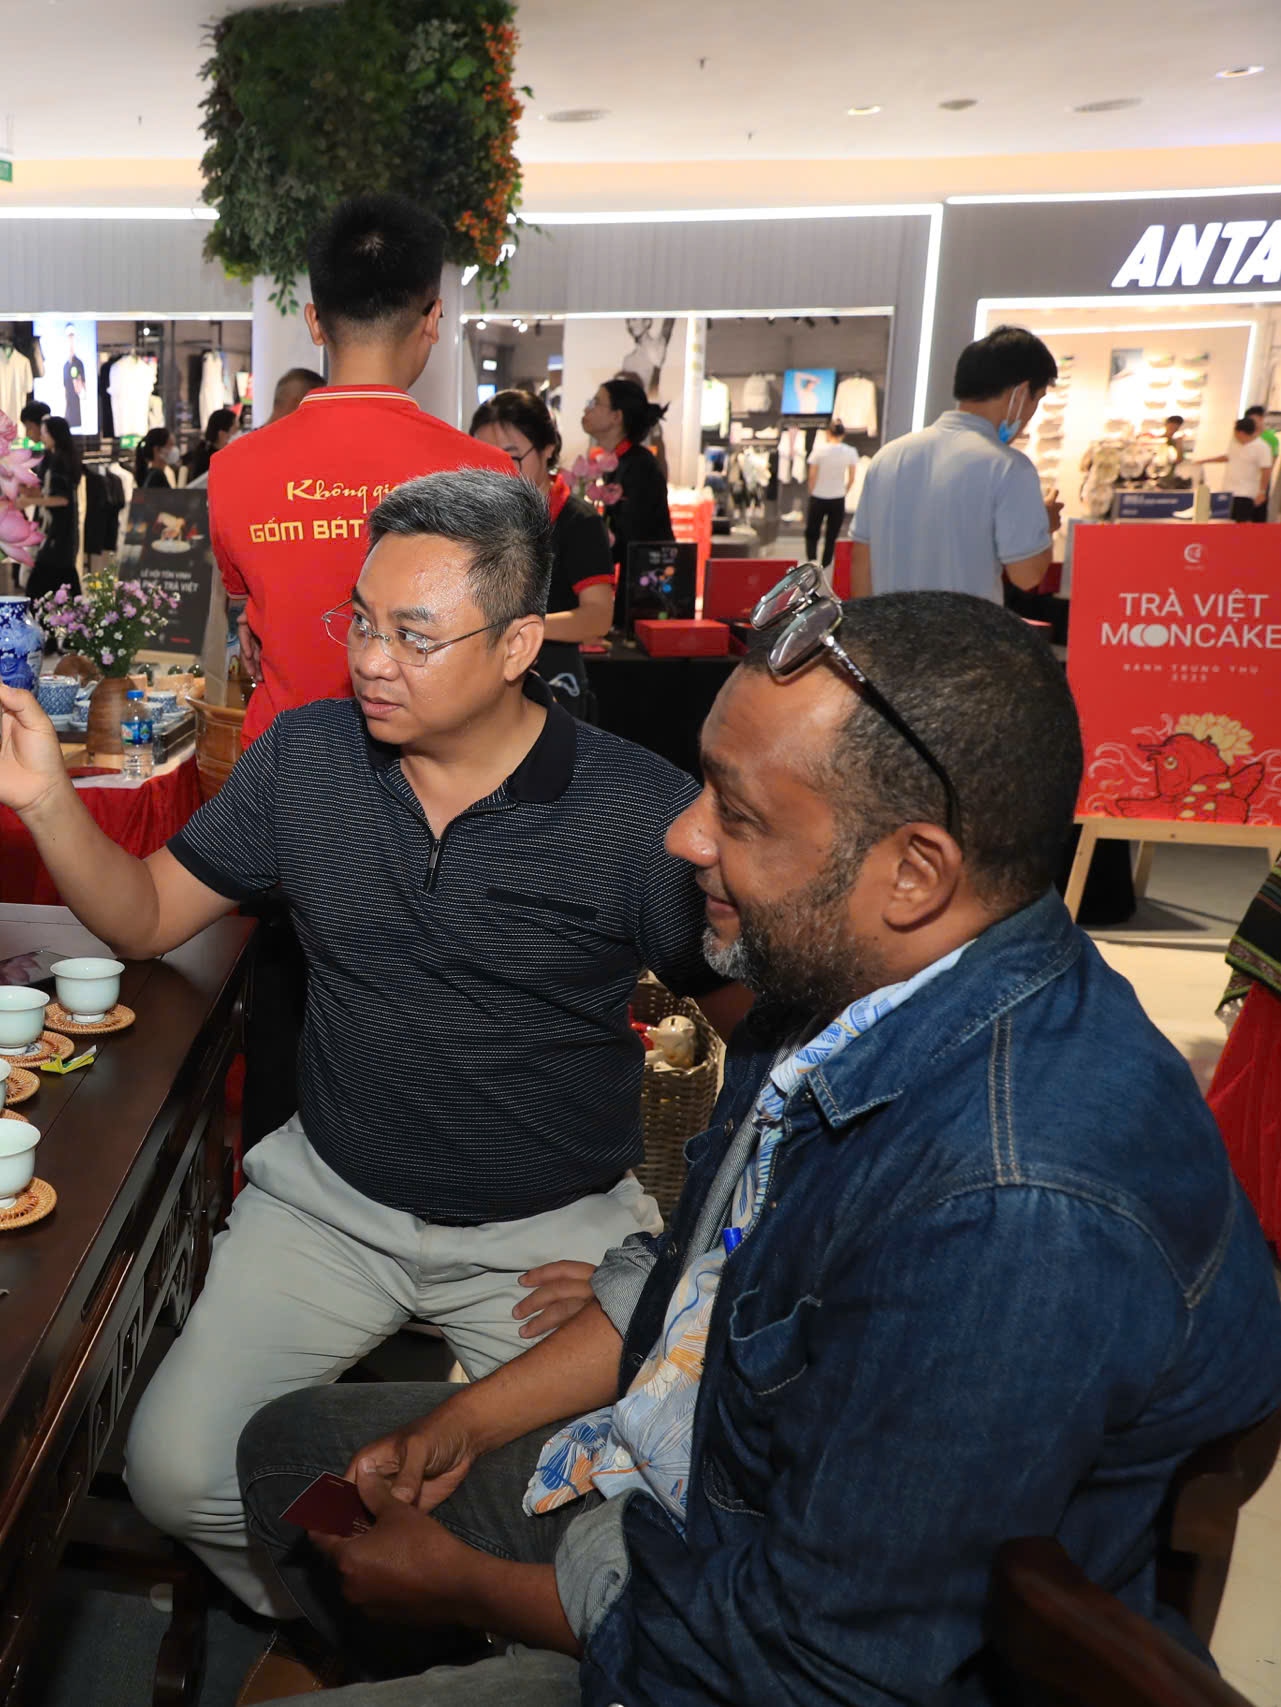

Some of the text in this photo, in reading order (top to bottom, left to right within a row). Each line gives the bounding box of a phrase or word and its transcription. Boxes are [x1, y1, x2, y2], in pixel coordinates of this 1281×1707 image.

[1111, 219, 1281, 288] ANTA
[287, 479, 368, 514] Không
[250, 516, 364, 543] GỐM BÁT
[1119, 588, 1269, 622] TRÀ VIỆT
